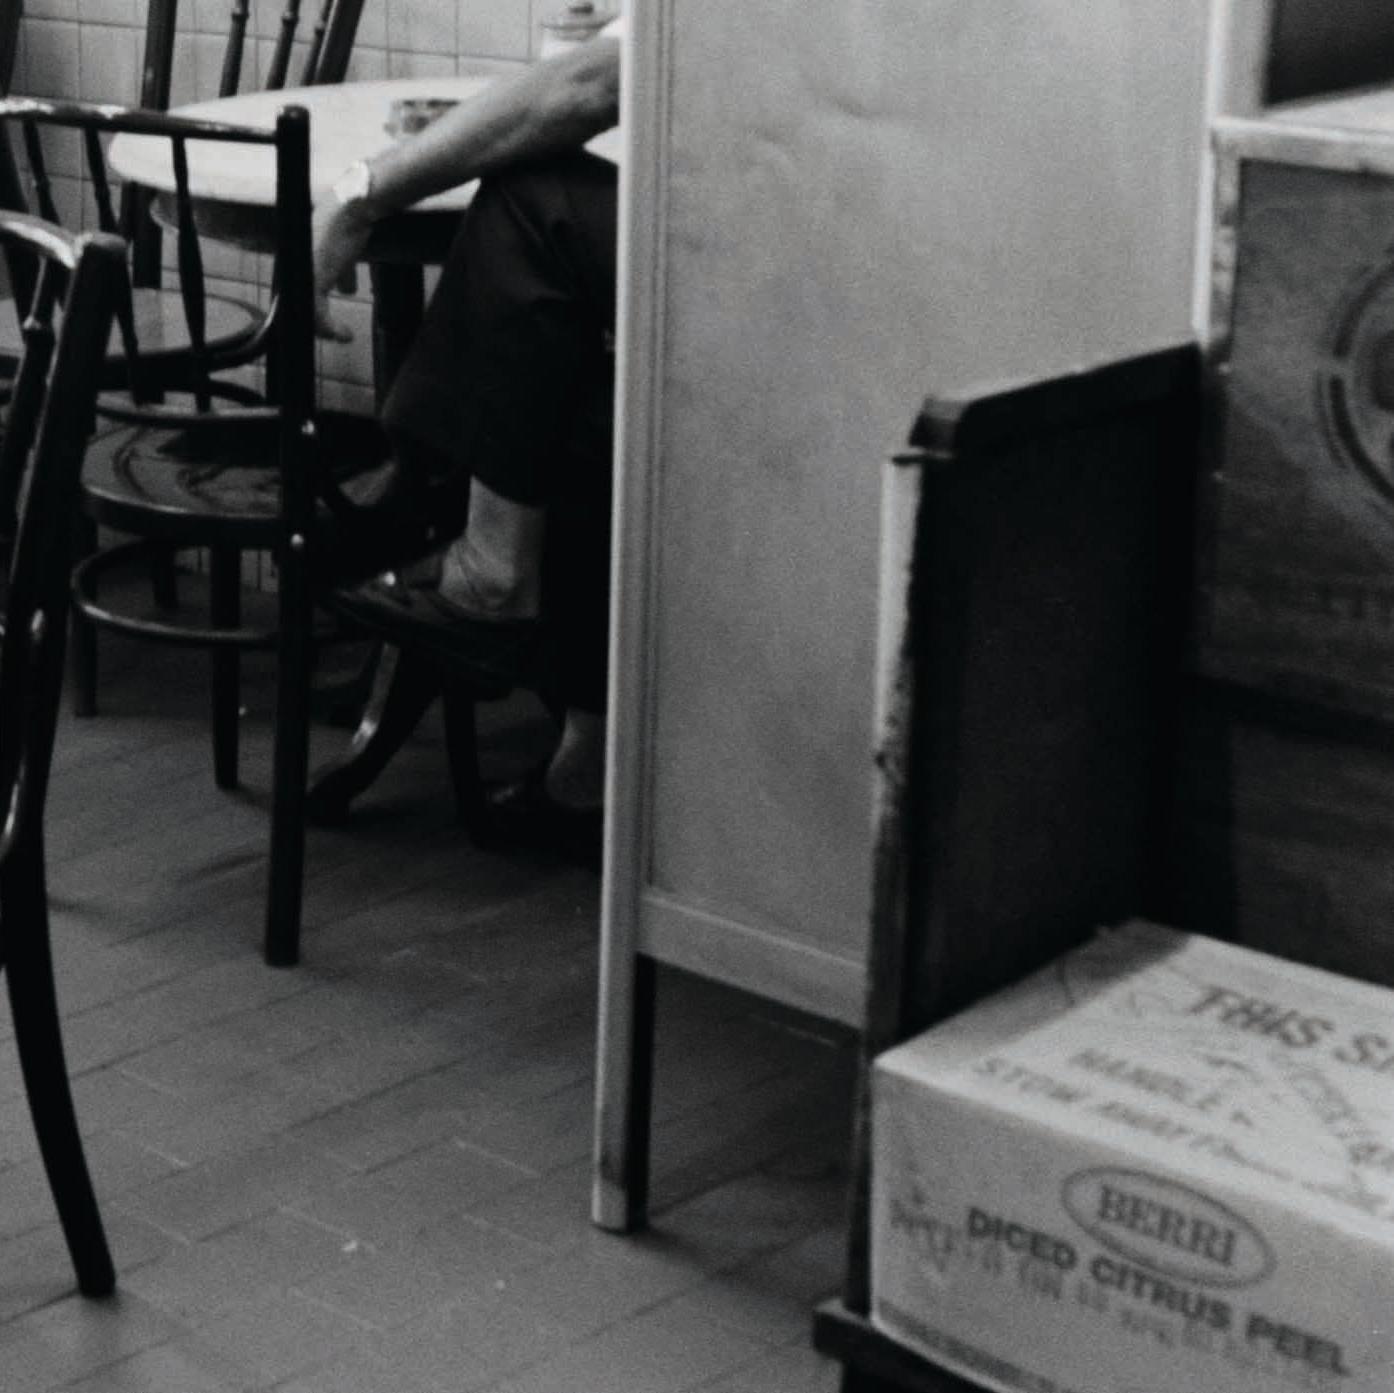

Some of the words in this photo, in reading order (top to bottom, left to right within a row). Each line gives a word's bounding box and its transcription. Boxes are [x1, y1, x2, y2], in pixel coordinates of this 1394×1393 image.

[1189, 985, 1335, 1050] THIS
[1098, 1184, 1238, 1269] BERRI
[966, 1205, 1079, 1273] DICED
[1091, 1255, 1234, 1332] CITRUS
[1245, 1313, 1352, 1377] PEEL
